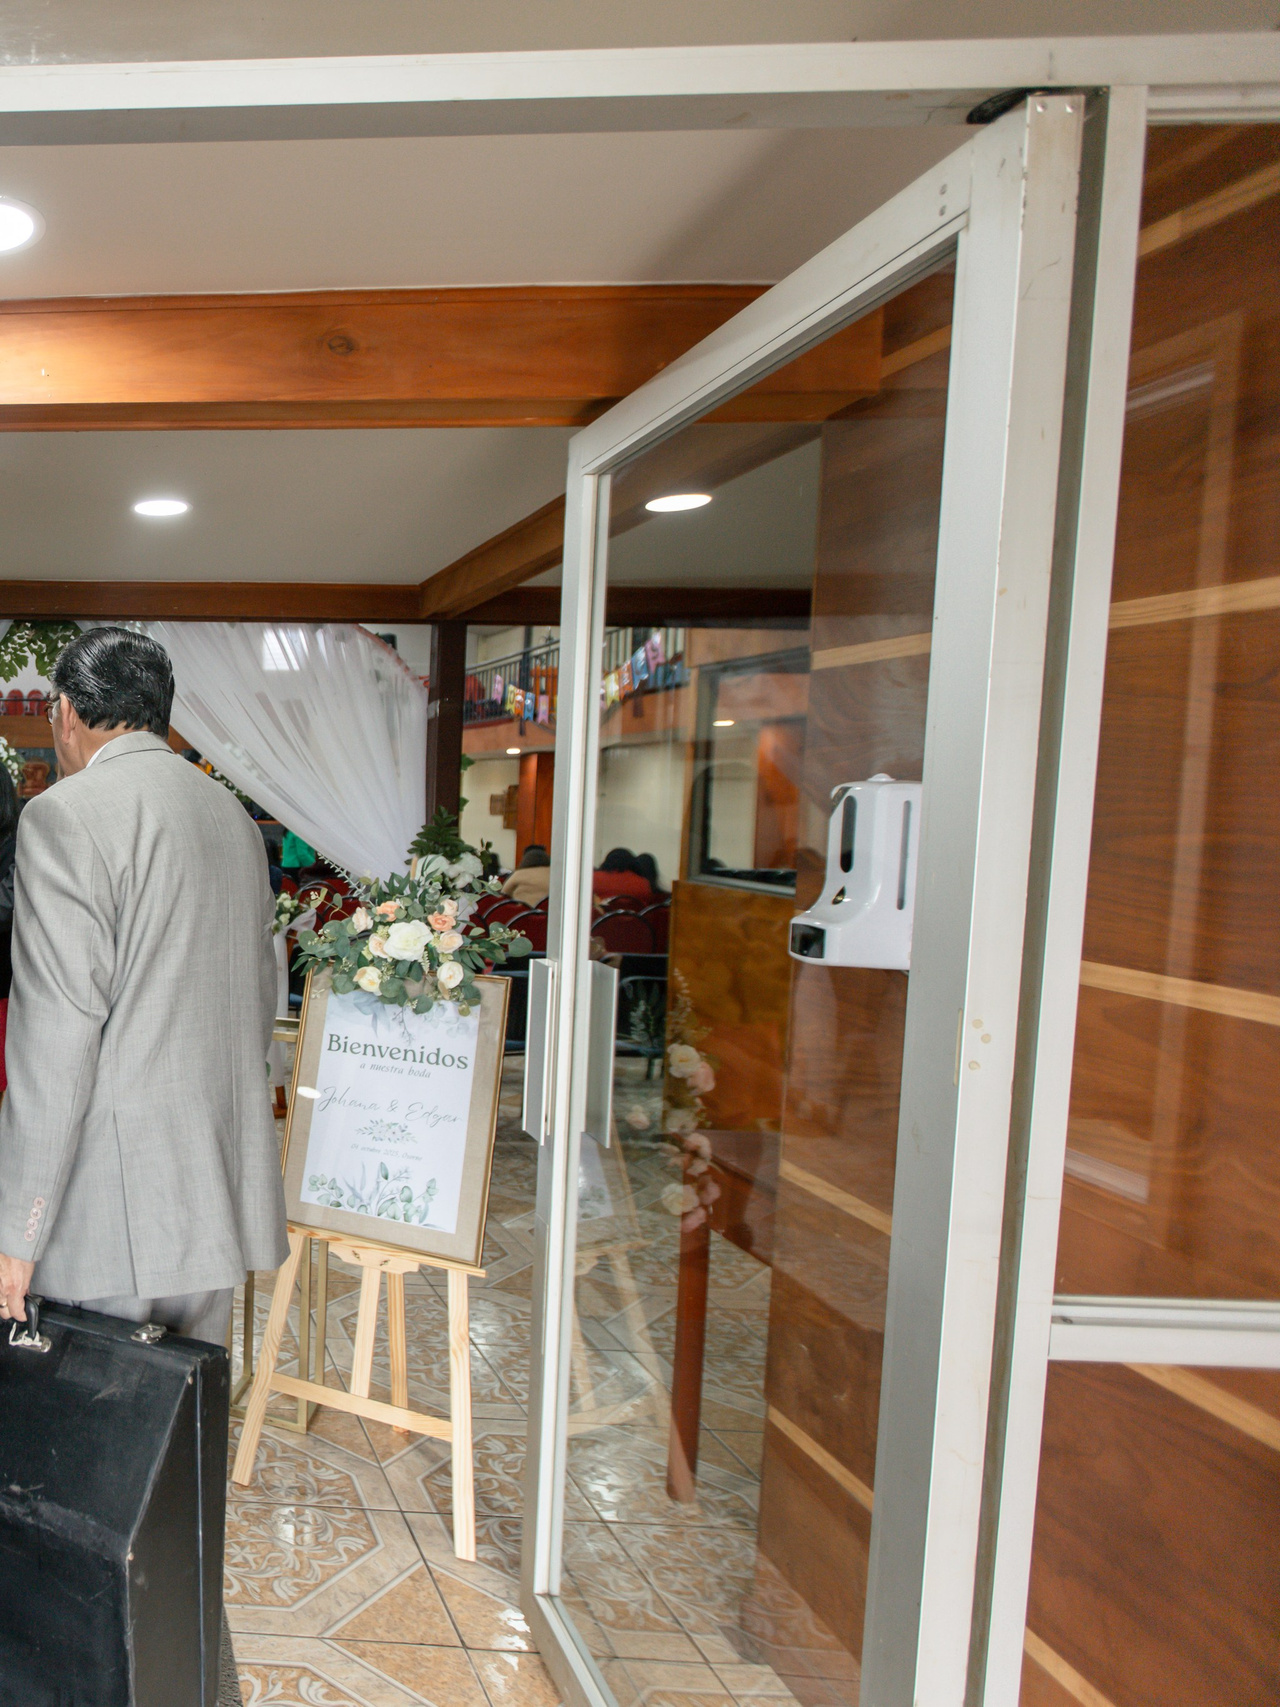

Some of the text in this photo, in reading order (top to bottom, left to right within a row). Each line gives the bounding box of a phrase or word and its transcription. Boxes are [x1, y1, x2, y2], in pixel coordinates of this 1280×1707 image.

[326, 1033, 469, 1070] Bienvenidos
[359, 1062, 432, 1079] a nuestra boda
[318, 1086, 463, 1128] Johana & Edgar
